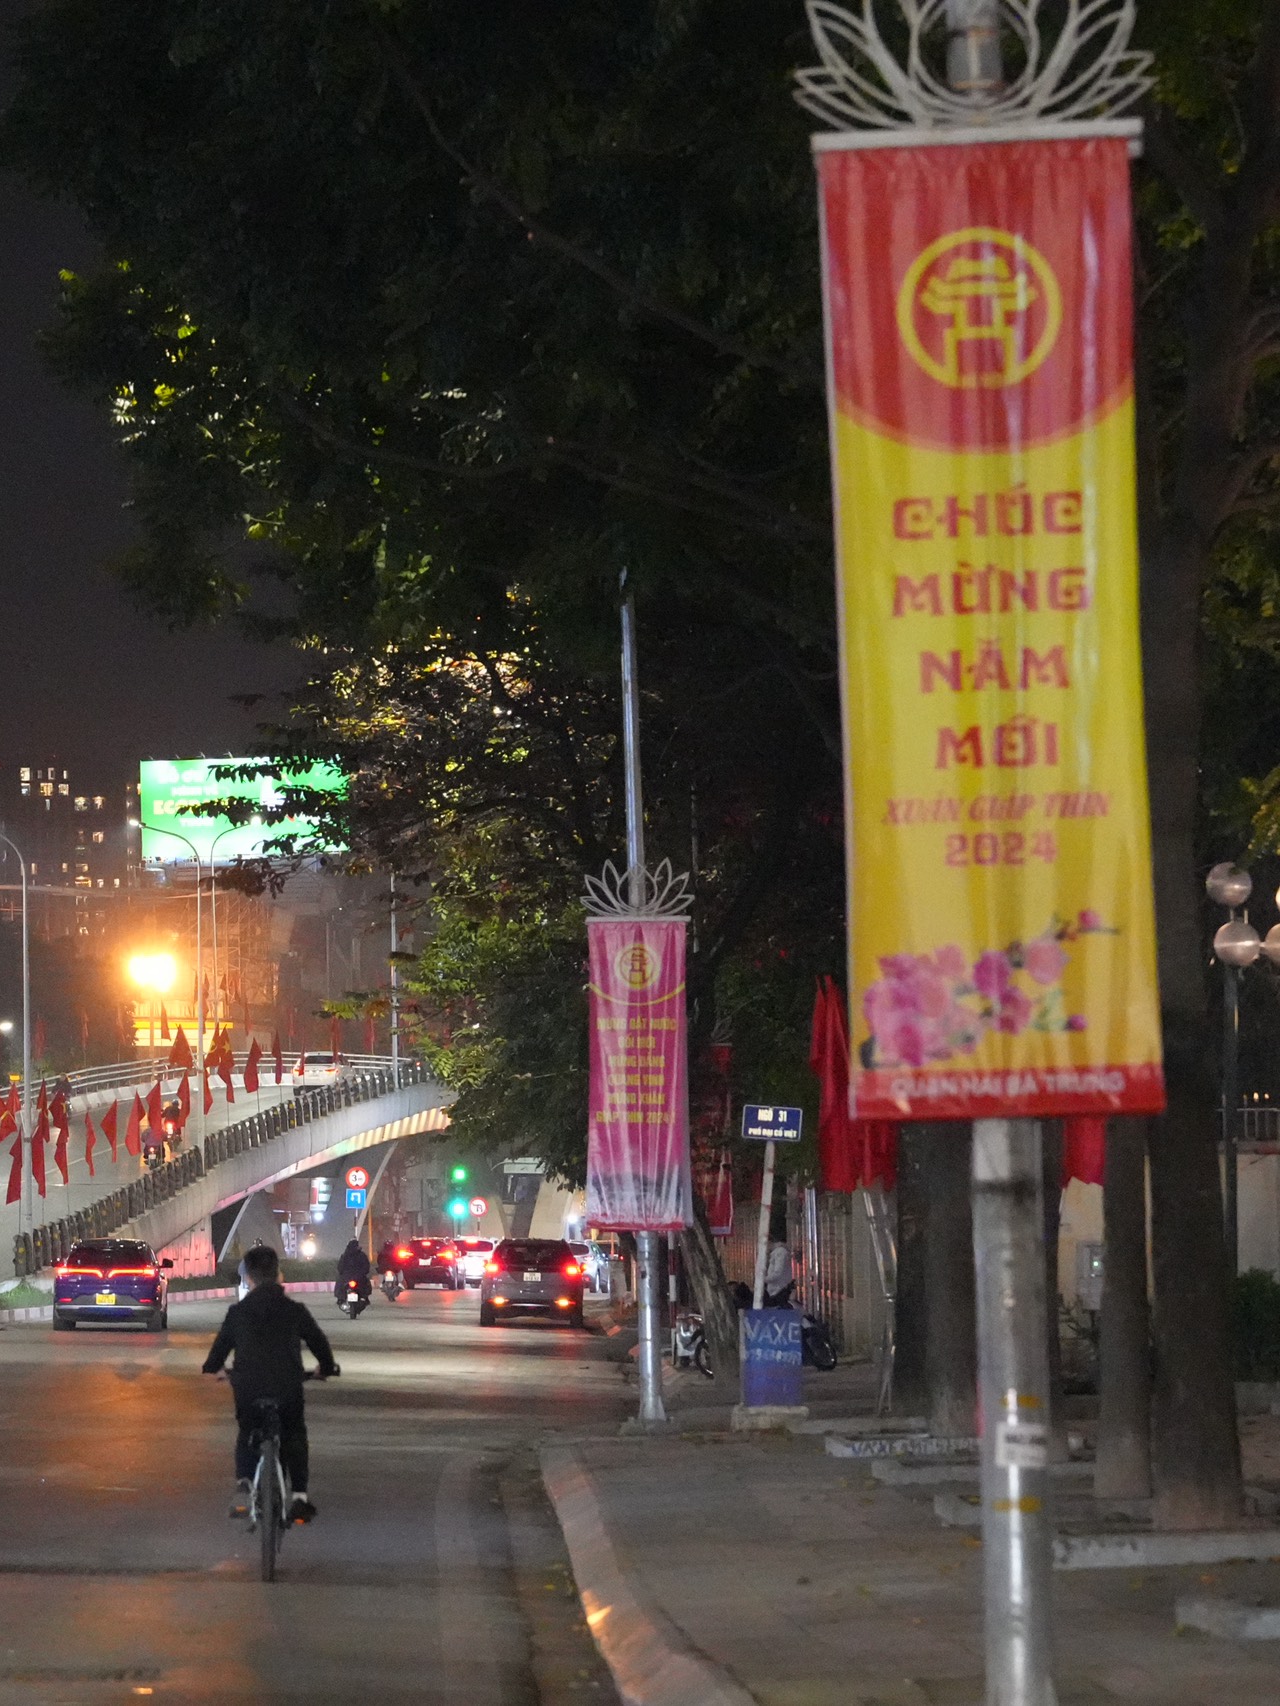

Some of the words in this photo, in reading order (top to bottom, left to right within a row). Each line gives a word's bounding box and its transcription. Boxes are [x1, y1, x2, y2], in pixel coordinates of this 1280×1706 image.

[893, 481, 1083, 541] CHÚC
[892, 560, 1090, 619] MỪNG
[919, 637, 1070, 693] NĂM
[934, 713, 1058, 770] MỚI
[945, 831, 1058, 867] 2024
[778, 1110, 787, 1122] 31
